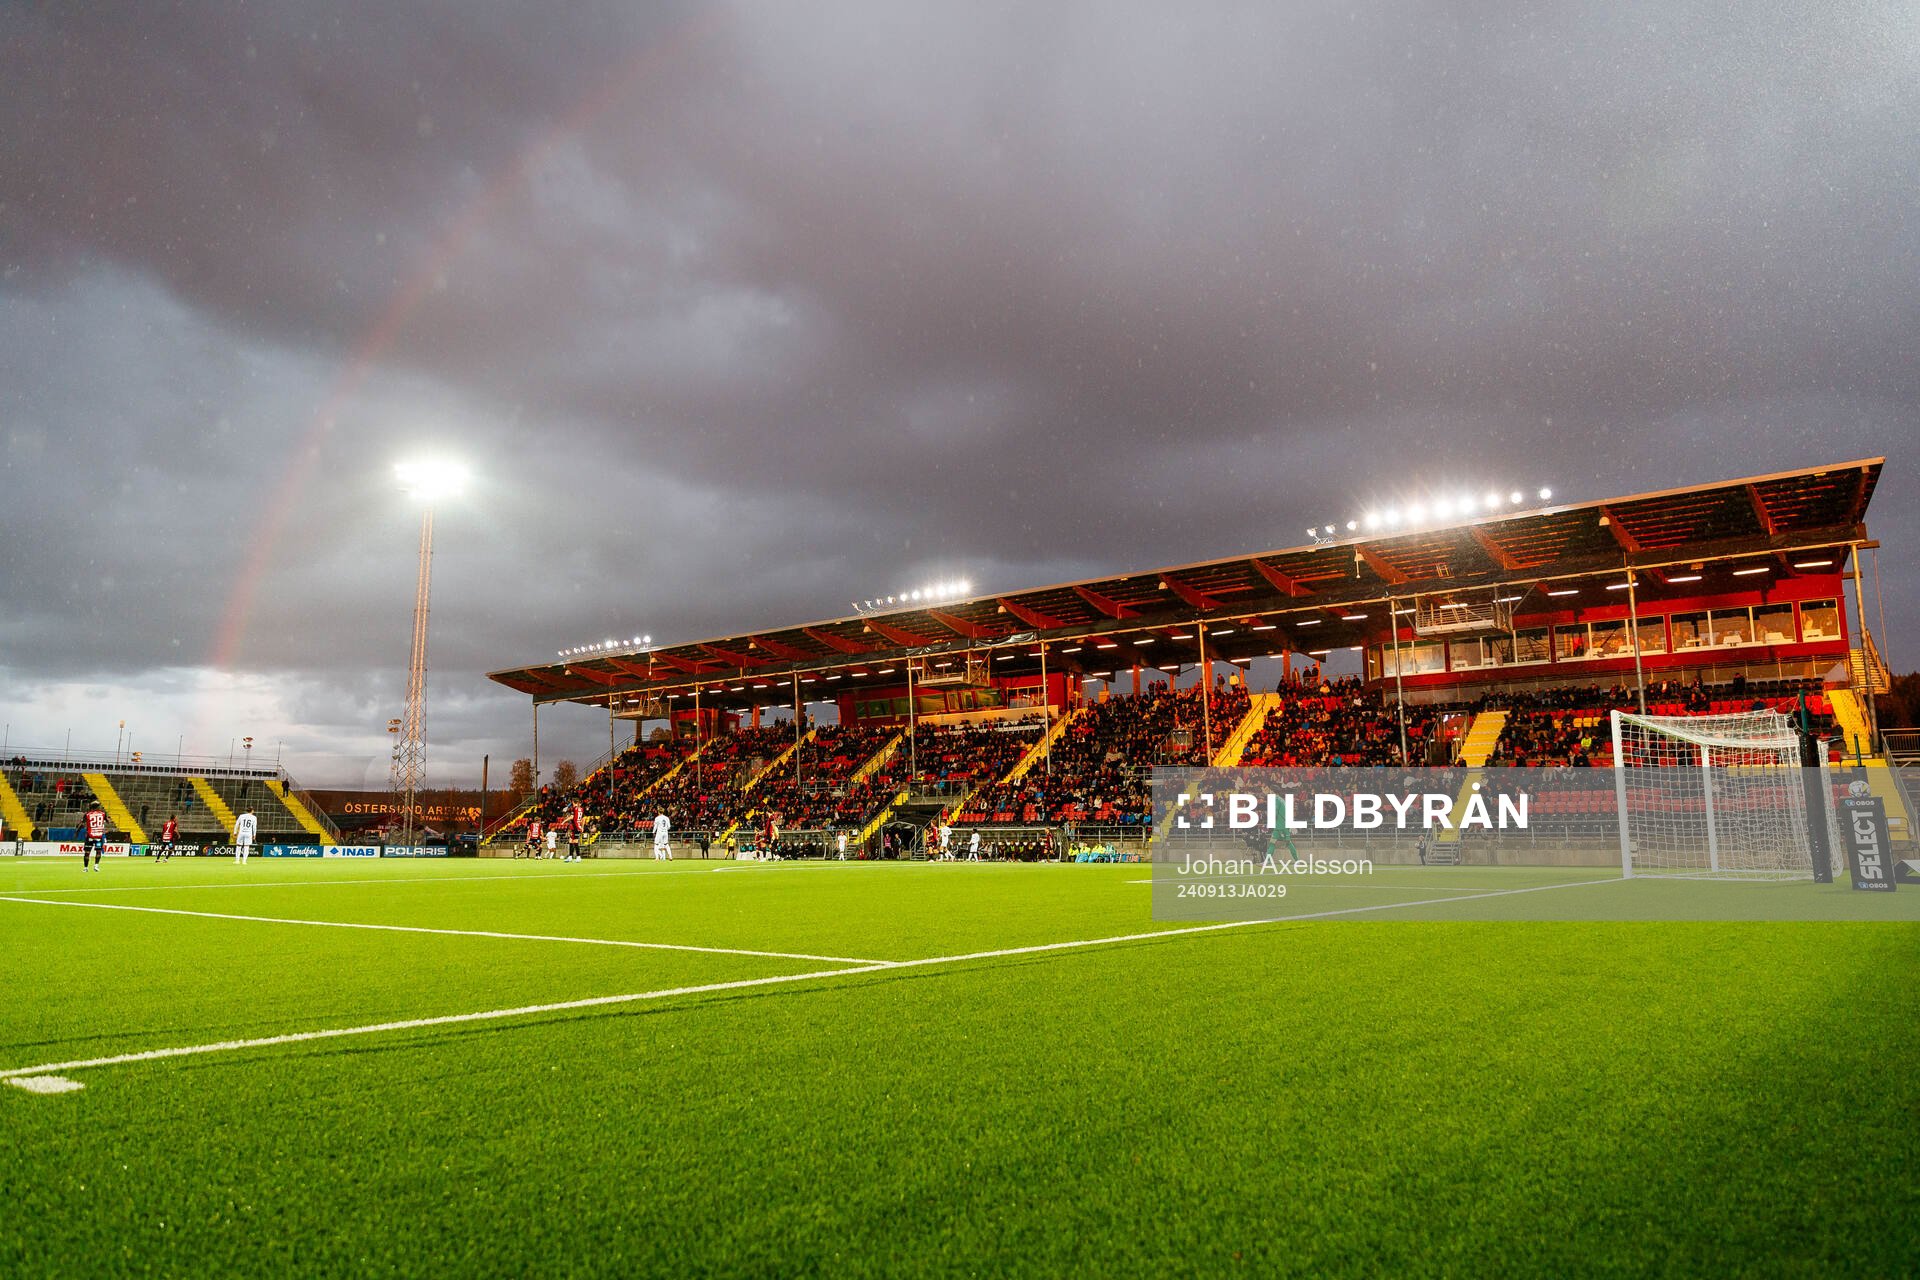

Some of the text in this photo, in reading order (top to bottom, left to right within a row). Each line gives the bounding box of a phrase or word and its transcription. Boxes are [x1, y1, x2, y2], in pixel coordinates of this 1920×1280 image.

[344, 801, 423, 815] ÖSTERSUND
[89, 814, 104, 828] 28
[243, 819, 252, 829] 16
[59, 845, 84, 853] MAX
[1851, 810, 1884, 879] SELECT
[342, 848, 375, 856] INAB
[385, 847, 447, 856] POLARIS
